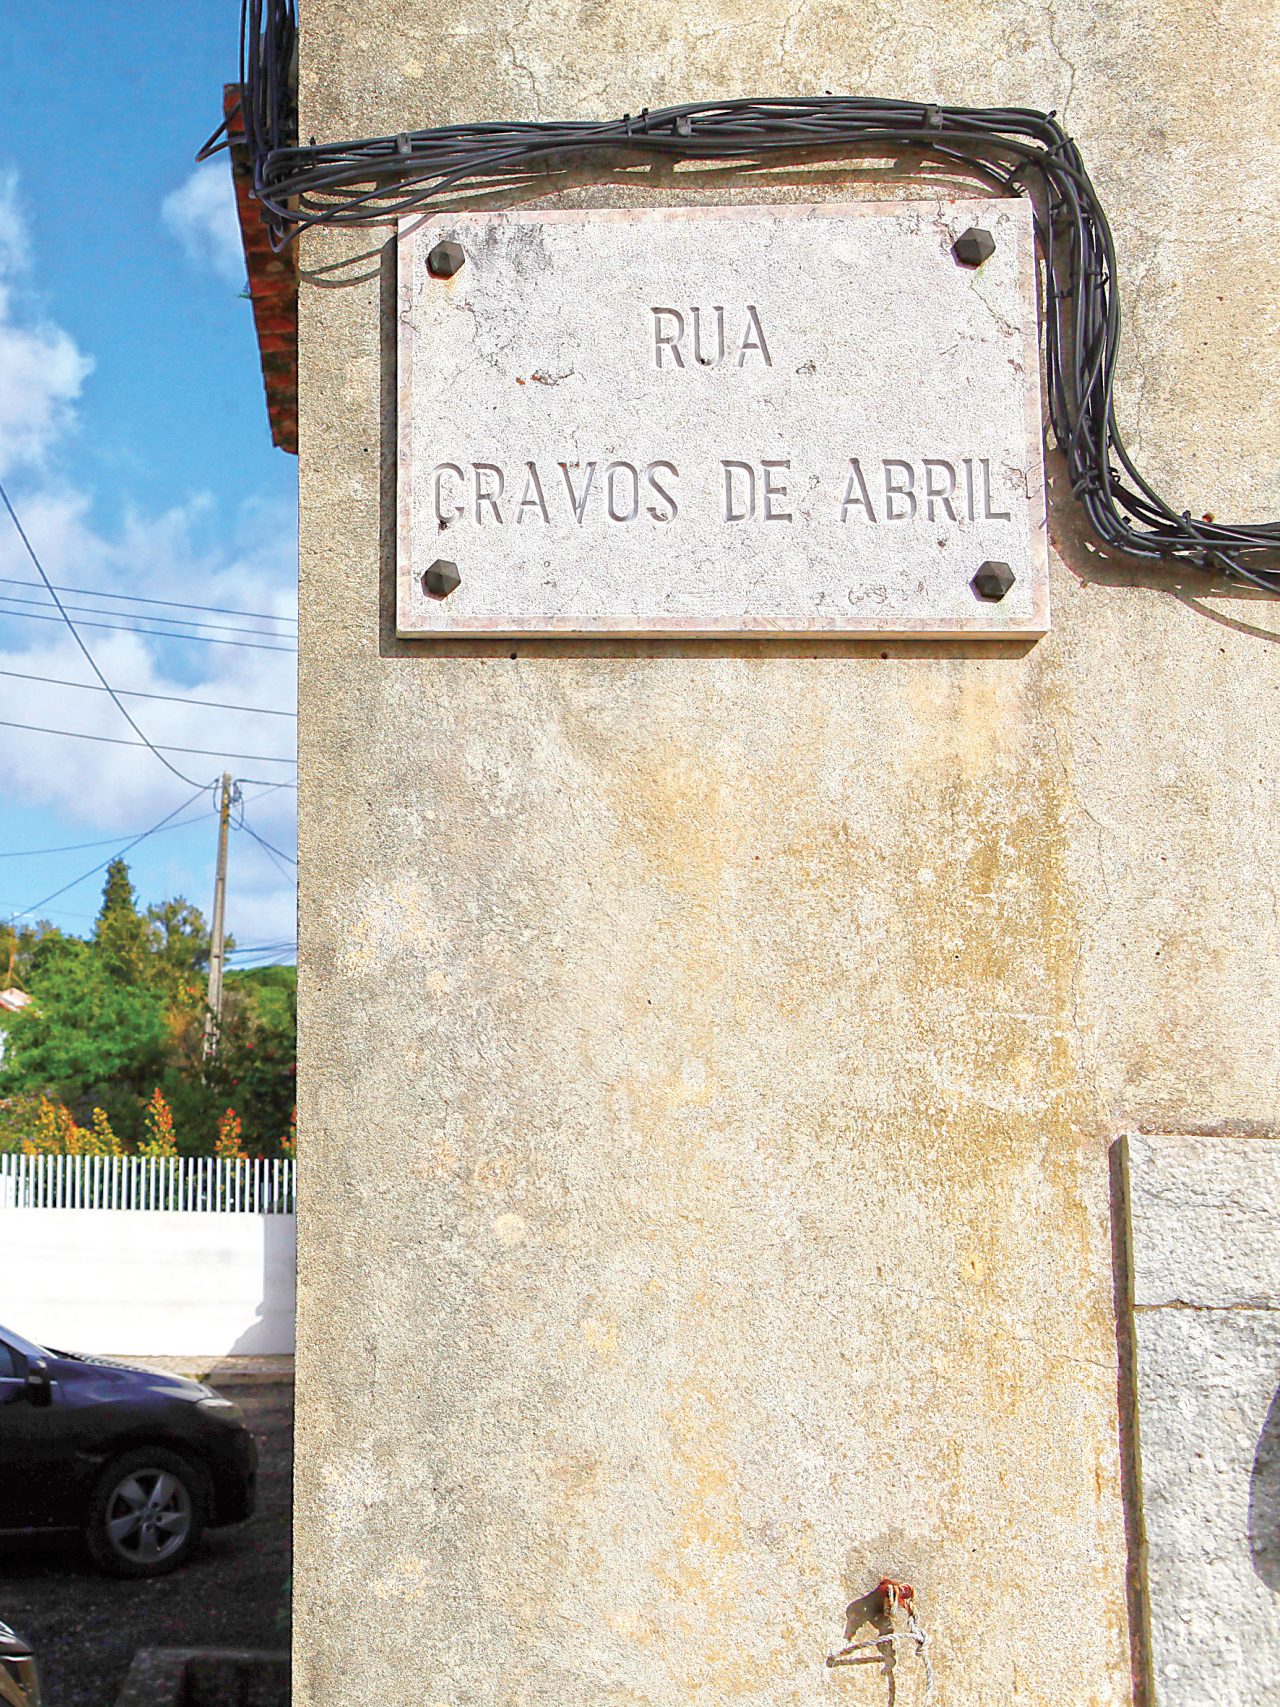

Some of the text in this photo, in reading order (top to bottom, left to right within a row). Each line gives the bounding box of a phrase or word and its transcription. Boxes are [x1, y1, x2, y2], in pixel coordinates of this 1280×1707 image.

[651, 304, 773, 369] RUA
[433, 456, 1012, 526] CRAVOS DE ABRIL
